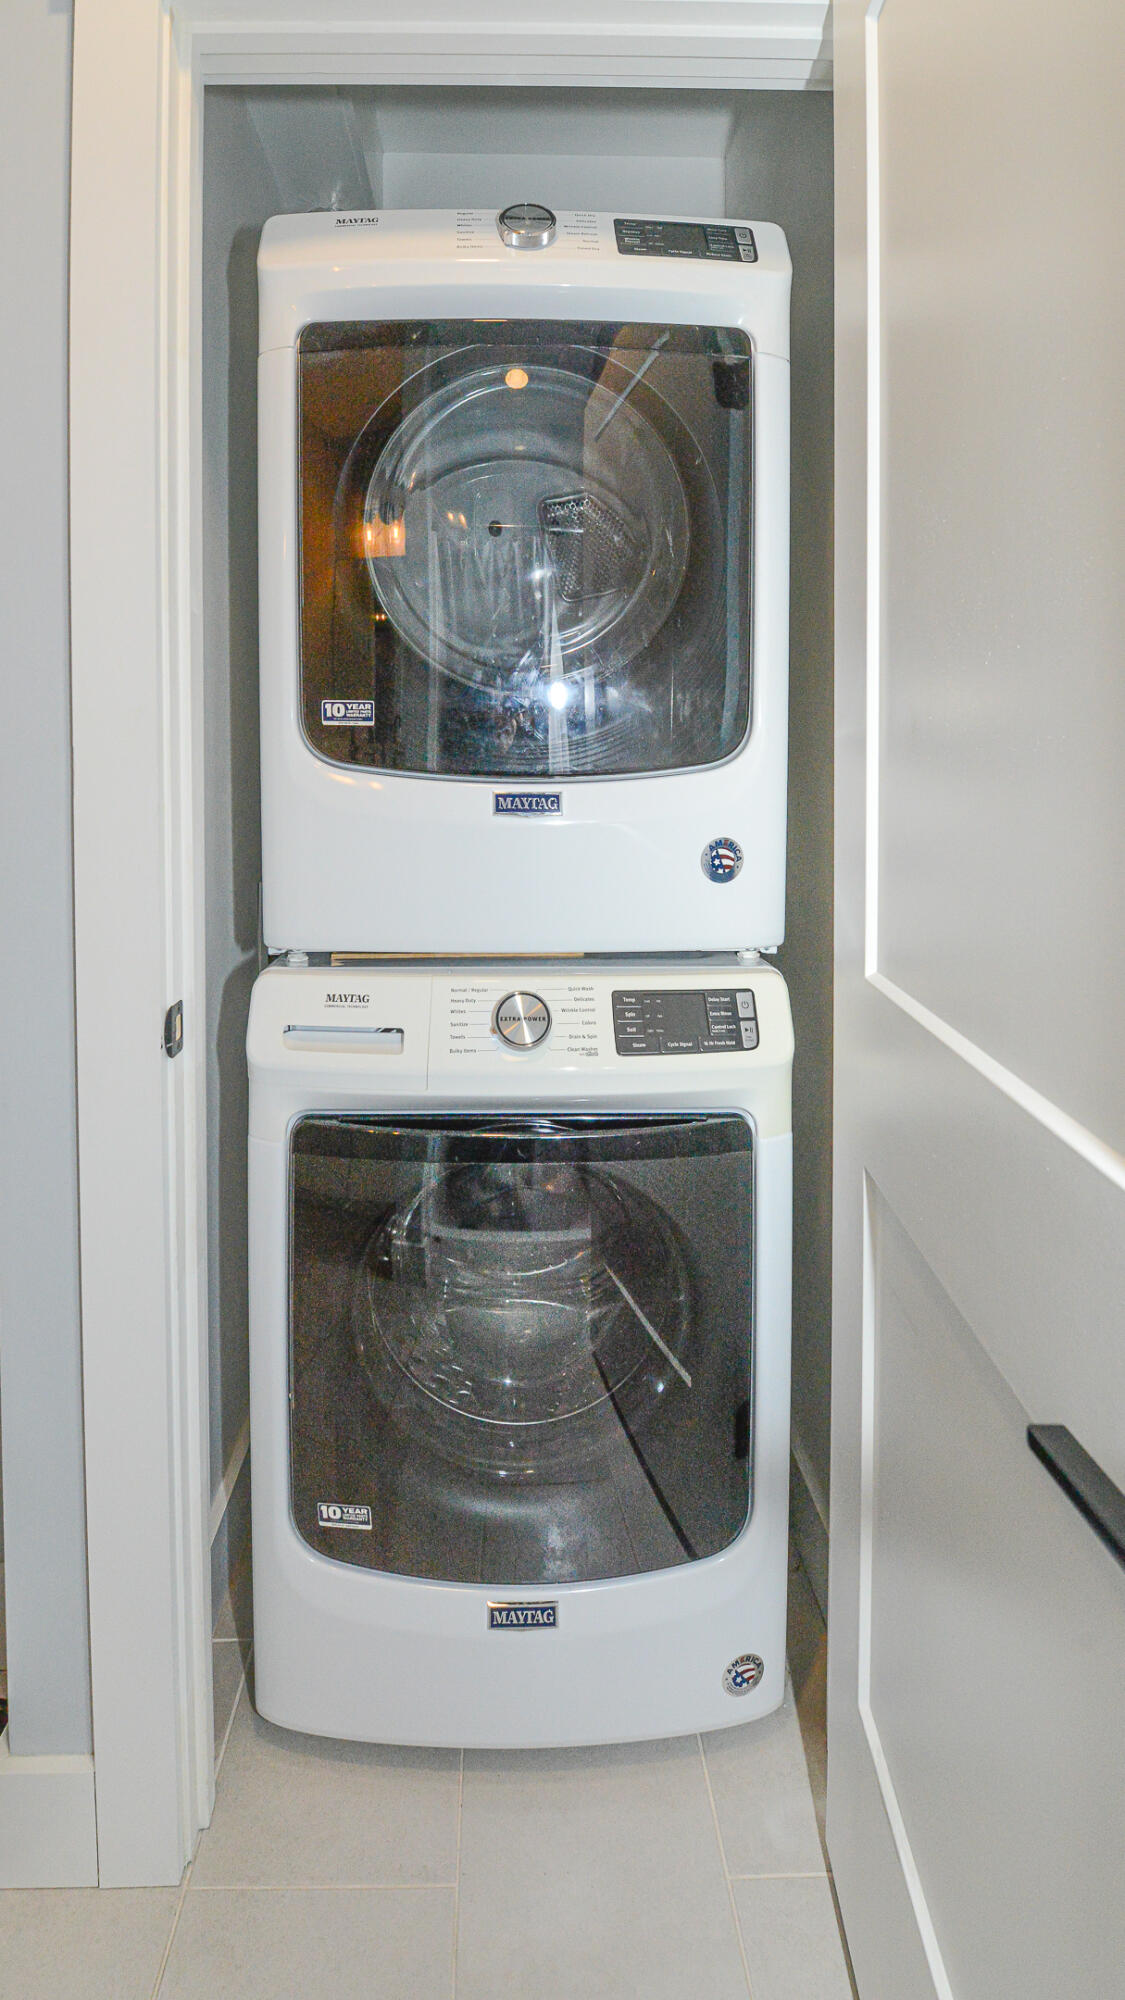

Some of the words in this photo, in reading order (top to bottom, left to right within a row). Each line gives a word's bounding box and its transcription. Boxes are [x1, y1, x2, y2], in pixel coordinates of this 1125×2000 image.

[335, 217, 379, 225] MAYTAG
[325, 703, 345, 717] 10
[497, 797, 559, 810] MAYTAG
[708, 839, 743, 863] AMERICA
[325, 993, 370, 1003] MAYTAG
[320, 1505, 342, 1520] 10
[492, 1609, 555, 1625] MAYTAG
[727, 1655, 762, 1675] AMERICA
